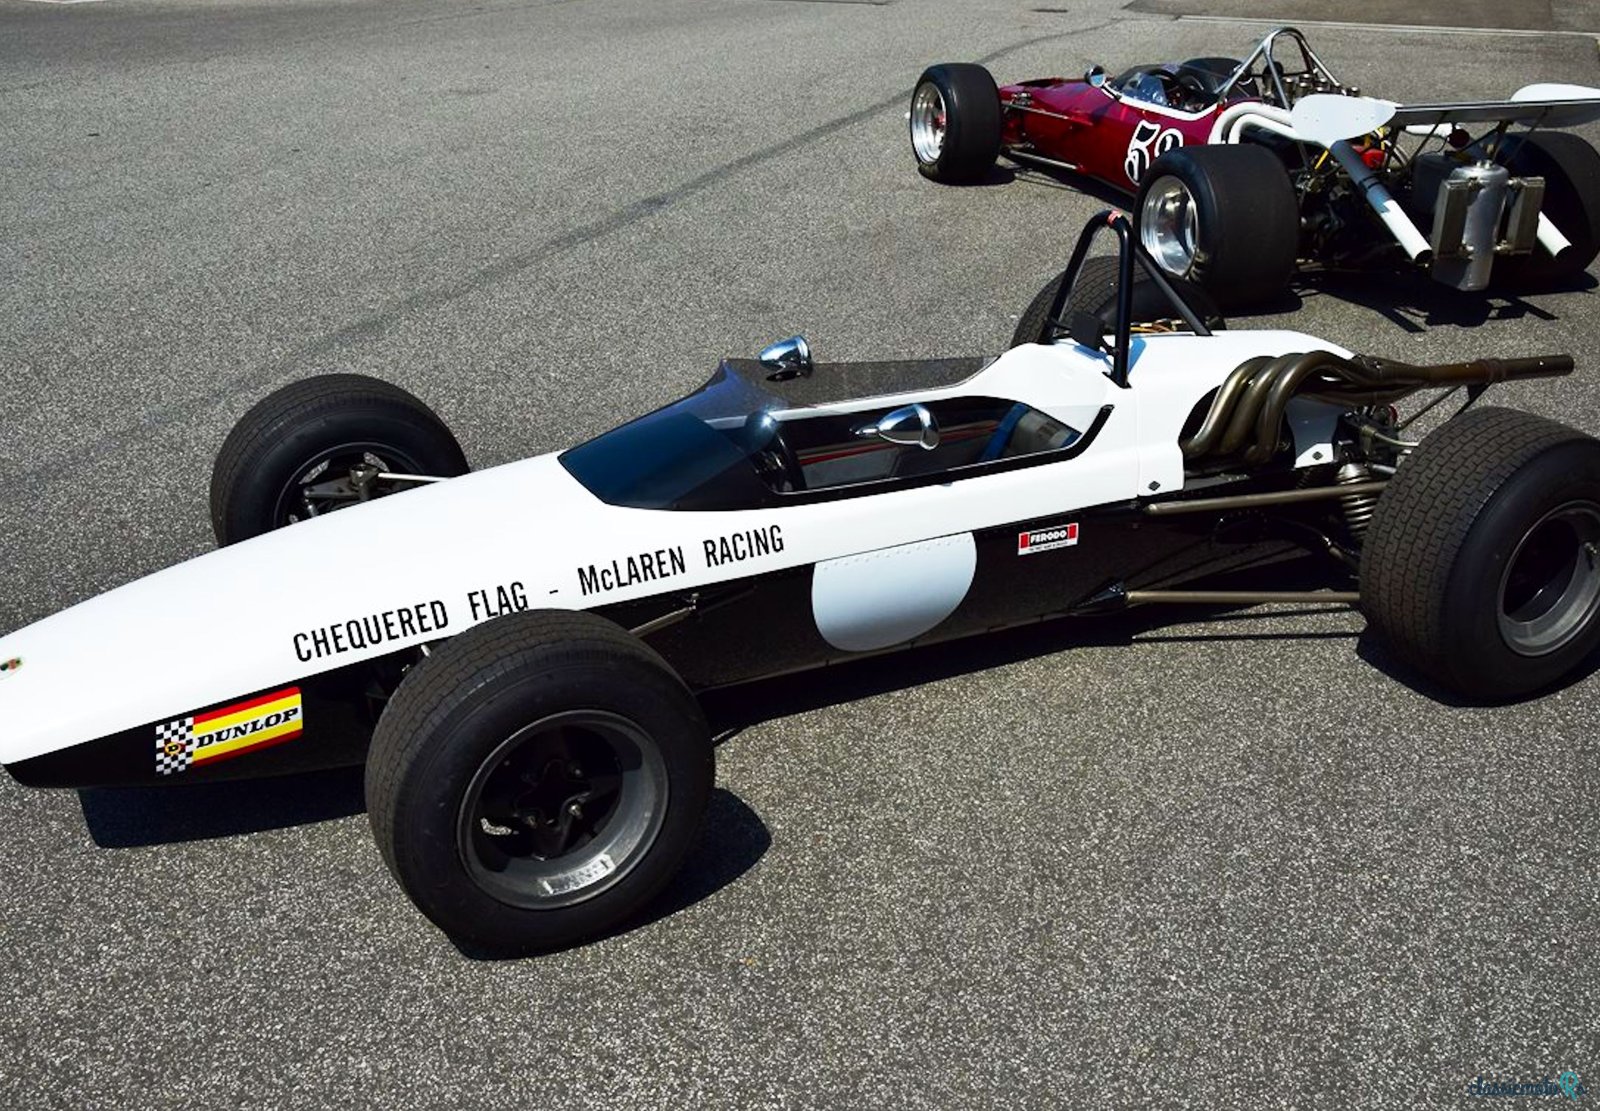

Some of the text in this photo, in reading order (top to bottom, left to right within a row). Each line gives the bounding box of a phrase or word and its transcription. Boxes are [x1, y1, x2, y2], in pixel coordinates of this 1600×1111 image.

[1030, 529, 1067, 543] FERODO
[293, 600, 449, 662] CHEQUERED
[467, 581, 529, 621] FLAG
[578, 546, 686, 596] McLAREN
[703, 525, 784, 568] RACING
[196, 707, 298, 749] DUNLOP
